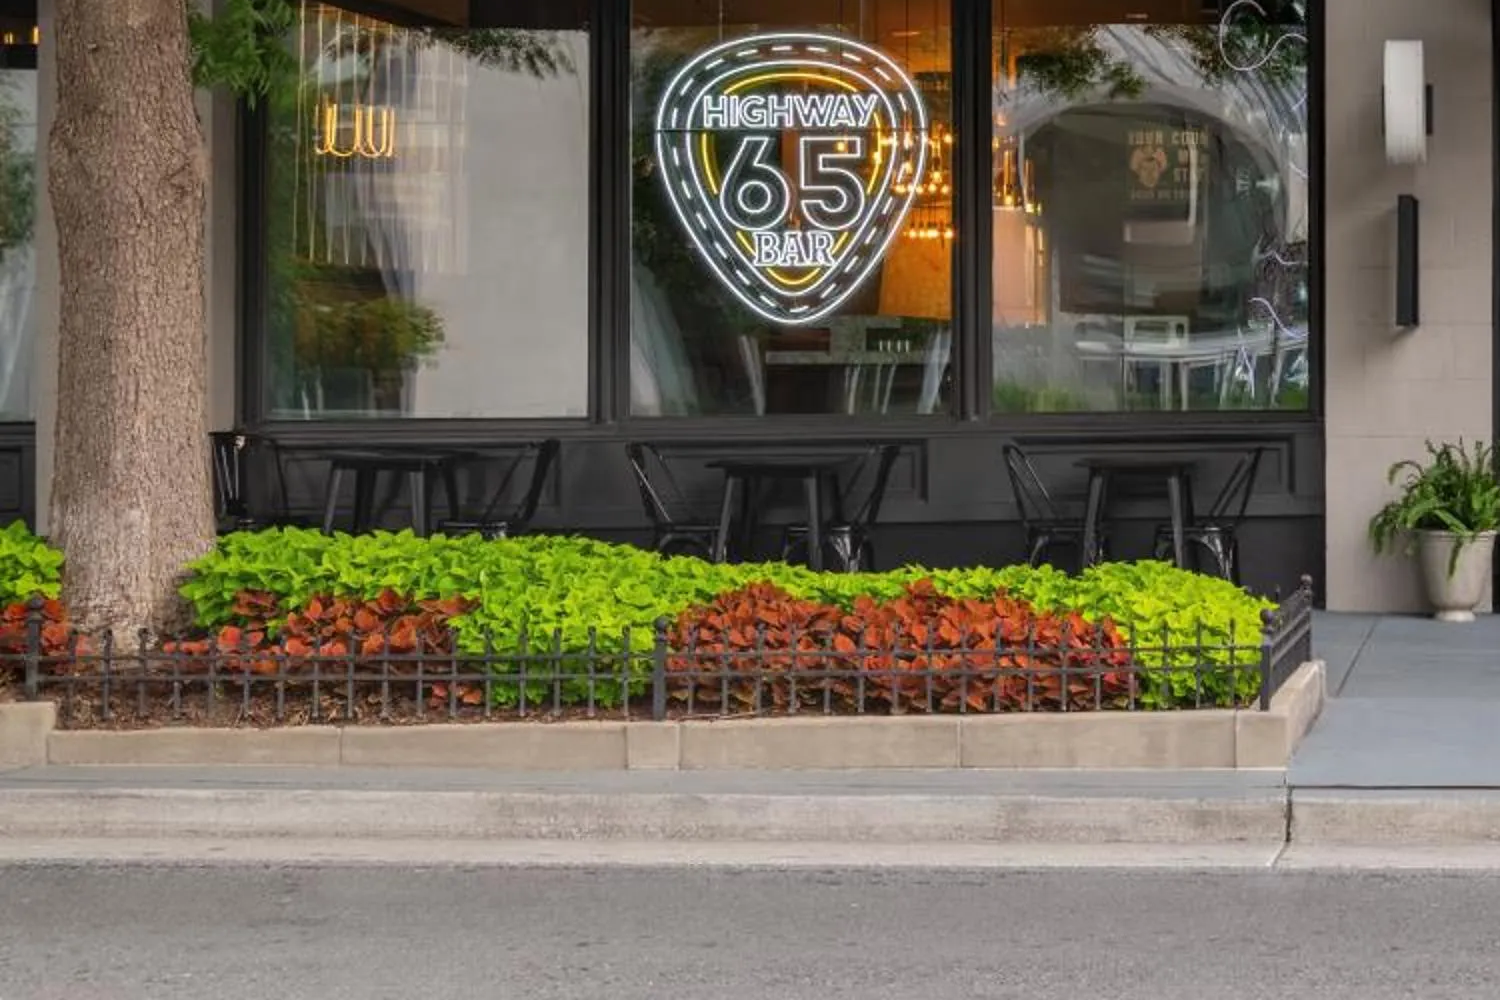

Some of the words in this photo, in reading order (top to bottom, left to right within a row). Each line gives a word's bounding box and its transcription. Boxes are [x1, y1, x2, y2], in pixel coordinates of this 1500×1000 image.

[702, 94, 880, 129] HIGHWAY
[719, 135, 866, 231] 65
[752, 230, 836, 267] BAR
